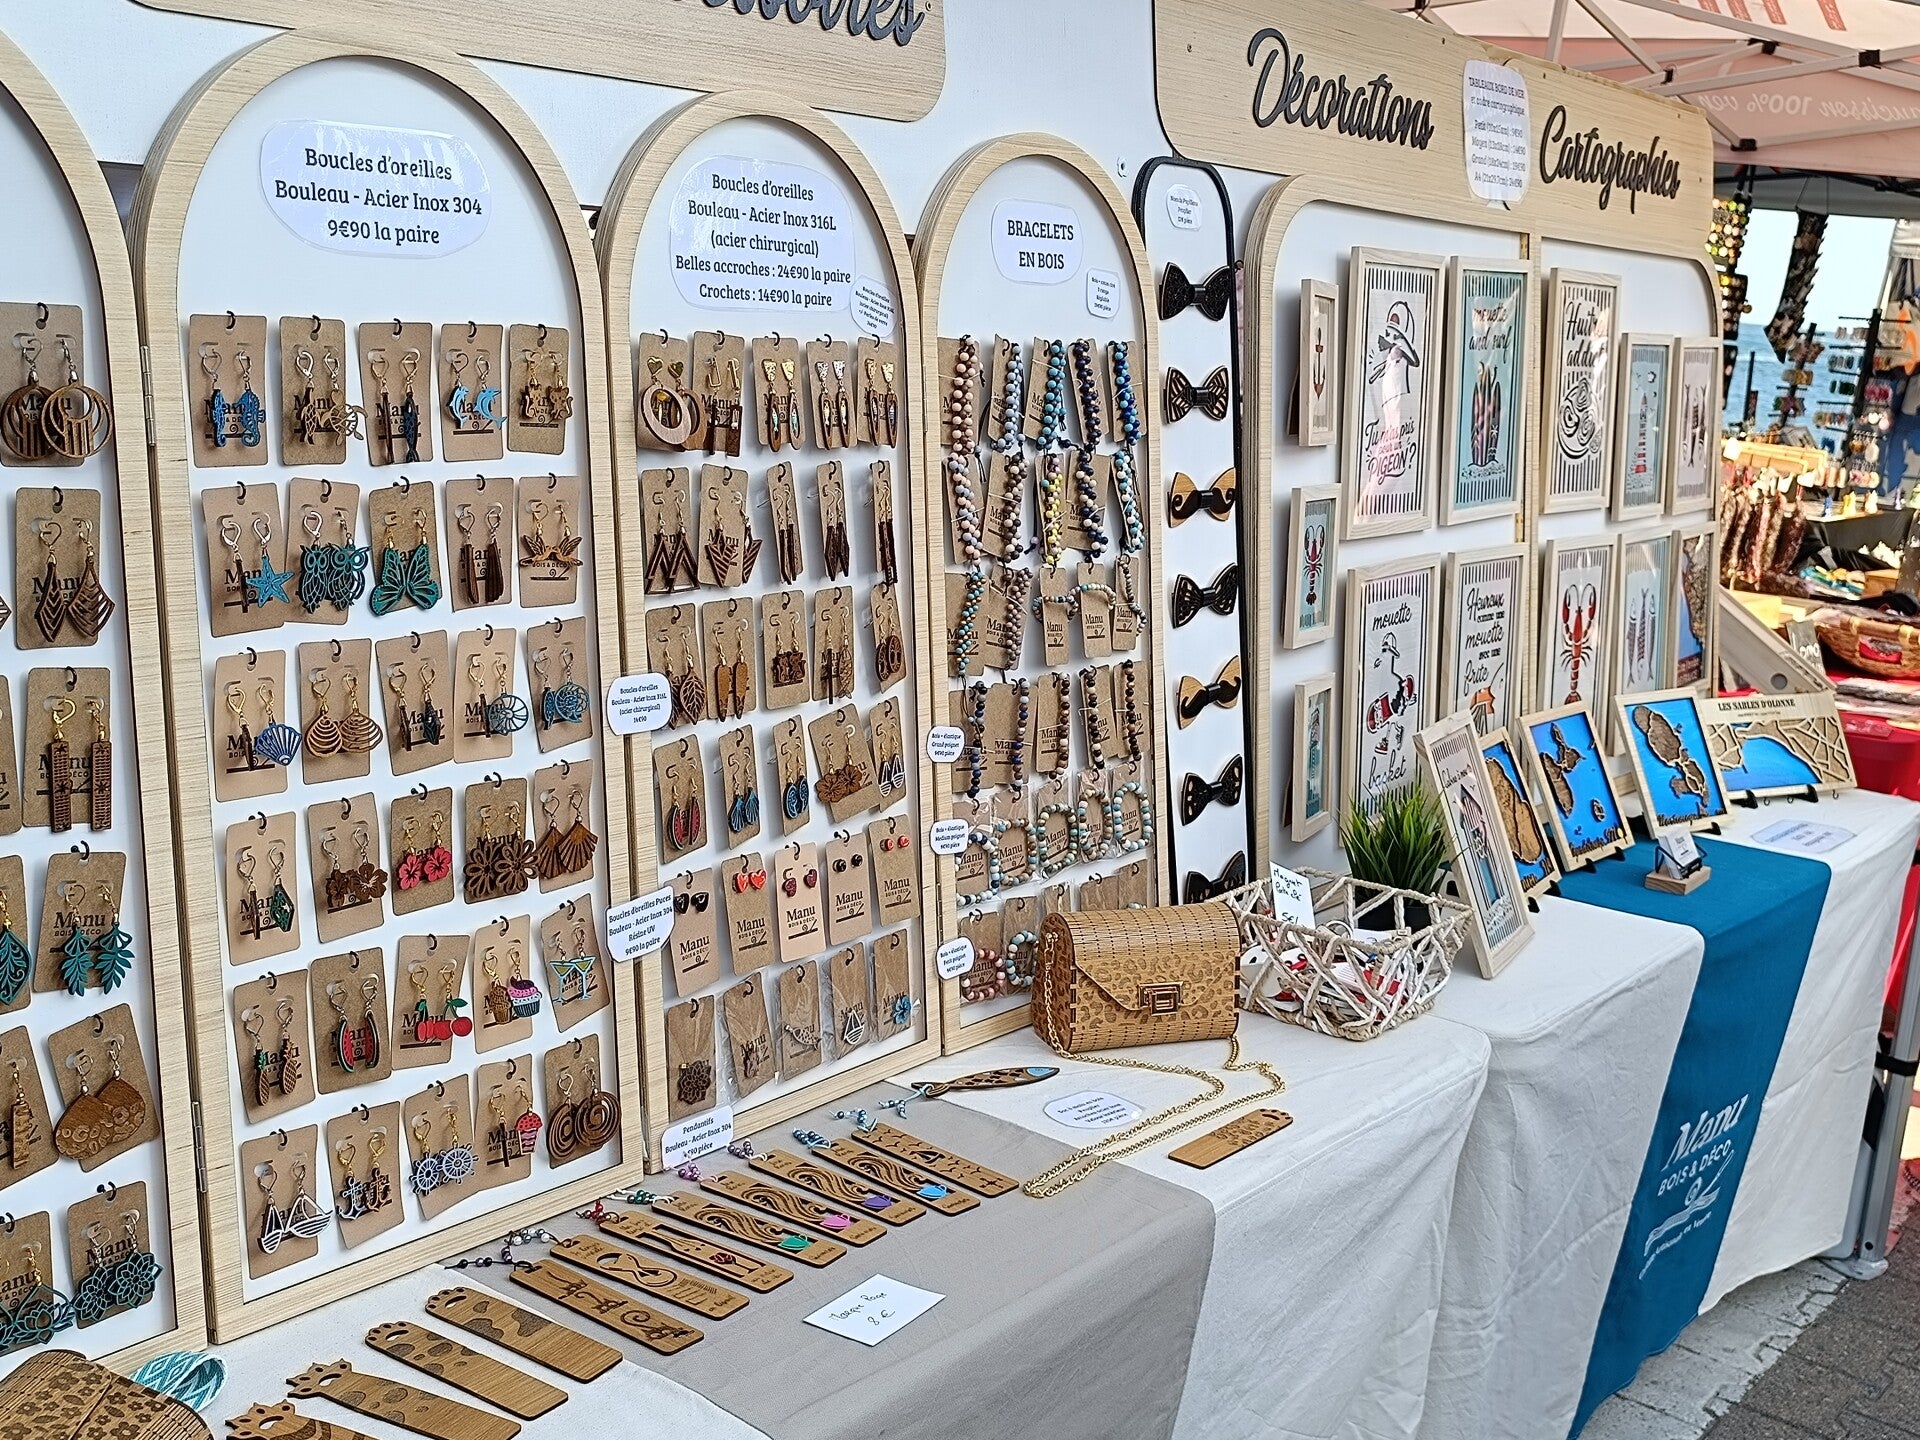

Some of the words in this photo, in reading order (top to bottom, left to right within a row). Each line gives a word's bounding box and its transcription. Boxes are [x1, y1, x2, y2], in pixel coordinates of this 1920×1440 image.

[1247, 27, 1434, 151] Décorations
[305, 148, 373, 173] Boucles
[377, 155, 452, 180] d'oreilles
[1539, 105, 1681, 214] Cartographies
[275, 180, 349, 204] Bouleau
[364, 188, 409, 209] Acier
[413, 193, 450, 213] Inox
[453, 197, 482, 215] 304
[712, 174, 759, 195] Boucles
[762, 180, 814, 201] d'oreilles
[688, 200, 740, 221] Bouleau
[749, 207, 781, 225] Acier
[783, 211, 809, 228] Inox
[811, 215, 837, 231] 316L
[327, 220, 370, 239] 9€90
[375, 222, 391, 241] la
[395, 225, 440, 246] paire
[711, 230, 747, 249] (acier
[749, 235, 819, 258] chirurgical)
[1007, 219, 1074, 241] BRACELETS
[675, 255, 711, 272] Belles
[713, 260, 770, 277] accroches
[777, 265, 809, 280] 24€90
[811, 268, 821, 282] la
[823, 269, 851, 285] paire
[1019, 251, 1035, 267] EN
[1038, 252, 1064, 270] BOIS
[699, 283, 751, 301] Crochets
[758, 289, 790, 303] 14€90
[791, 290, 802, 304] la
[804, 292, 832, 308] paire
[1365, 419, 1380, 451] Tu
[1399, 417, 1415, 440] pris
[1368, 442, 1417, 485] PIGEON?
[1372, 602, 1412, 631] mouette
[1467, 587, 1504, 621] Heureux
[1085, 613, 1104, 625] Manu
[1465, 621, 1504, 650] mouette
[1464, 660, 1488, 697] frite
[1718, 703, 1731, 712] LES
[1733, 701, 1759, 710] SABLES
[1760, 699, 1796, 708] D'OLONNE
[1369, 749, 1406, 789] basket
[835, 890, 864, 906] Manu
[884, 877, 910, 892] Manu
[609, 910, 630, 923] Boucles
[656, 895, 671, 906] Puces
[609, 923, 632, 936] Bouleau
[635, 915, 650, 926] Acier
[650, 910, 662, 920] Inox
[663, 906, 673, 916] 304
[786, 905, 816, 923] Manu
[629, 930, 647, 942] Résine
[647, 925, 656, 934] UV
[736, 917, 765, 934] Manu
[646, 937, 660, 950] paire
[679, 934, 710, 956] Manu
[665, 1140, 688, 1153] Bouleau
[692, 1132, 707, 1143] Acier
[708, 1128, 720, 1136] Inox
[721, 1123, 731, 1132] 304
[682, 1117, 714, 1134] Pendantifs
[1661, 1094, 1749, 1172] Manu
[698, 1142, 713, 1154] pièce
[1657, 1166, 1689, 1197] BOIS
[1689, 1160, 1698, 1177] &
[1698, 1139, 1731, 1172] DÉCO
